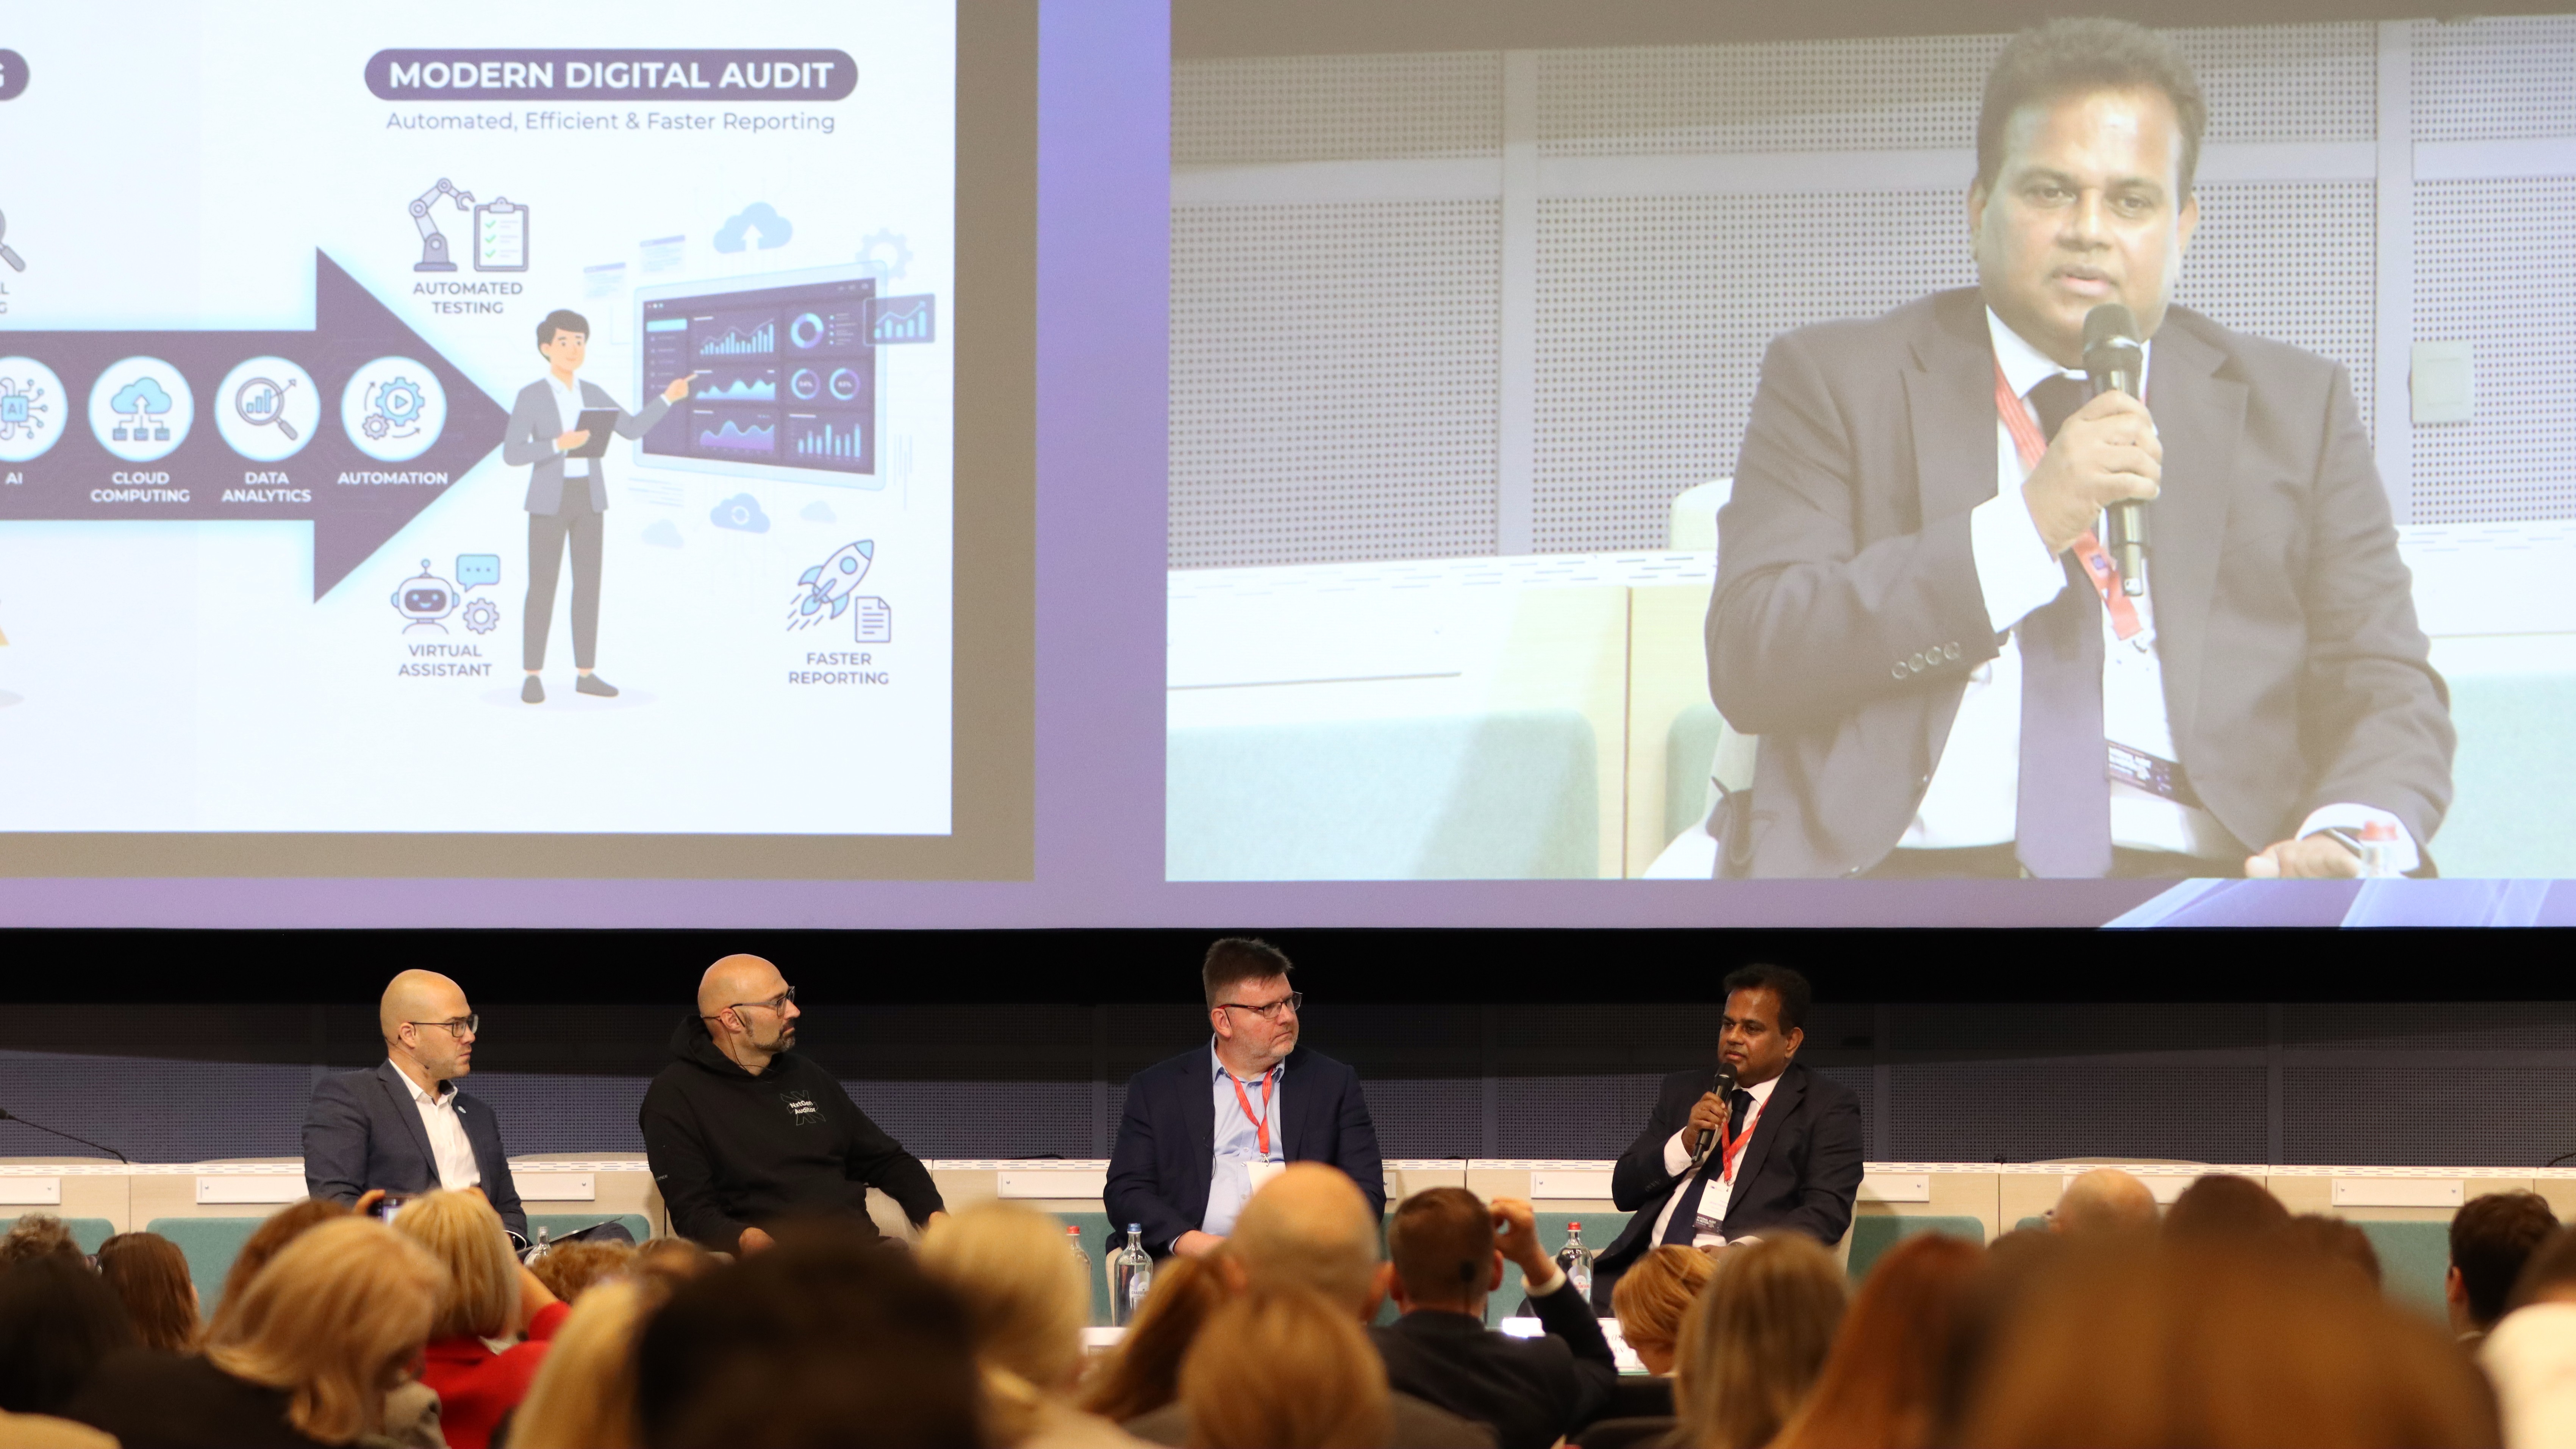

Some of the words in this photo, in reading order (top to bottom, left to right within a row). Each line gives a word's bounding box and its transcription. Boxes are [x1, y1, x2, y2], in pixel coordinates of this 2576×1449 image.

[391, 62, 553, 88] MODERN
[566, 62, 710, 89] DIGITAL
[719, 62, 835, 88] AUDIT
[386, 112, 518, 132] Automated,
[525, 111, 618, 130] Efficient
[625, 111, 640, 130] &
[647, 111, 716, 130] Faster
[723, 111, 835, 134] Reporting
[413, 281, 523, 295] AUTOMATED
[432, 301, 504, 314] TESTING
[8, 403, 23, 415] AI
[5, 472, 23, 485] AI
[112, 472, 170, 485] CLOUD
[245, 472, 289, 485] DATA
[337, 472, 449, 485] AUTOMATION
[90, 489, 190, 503] COMPUTING
[222, 489, 312, 503] ANALYTICS
[408, 644, 482, 658] VIRTUAL
[807, 652, 872, 666] FASTER
[398, 663, 492, 677] ASSISTANT
[788, 671, 889, 685] REPORTING
